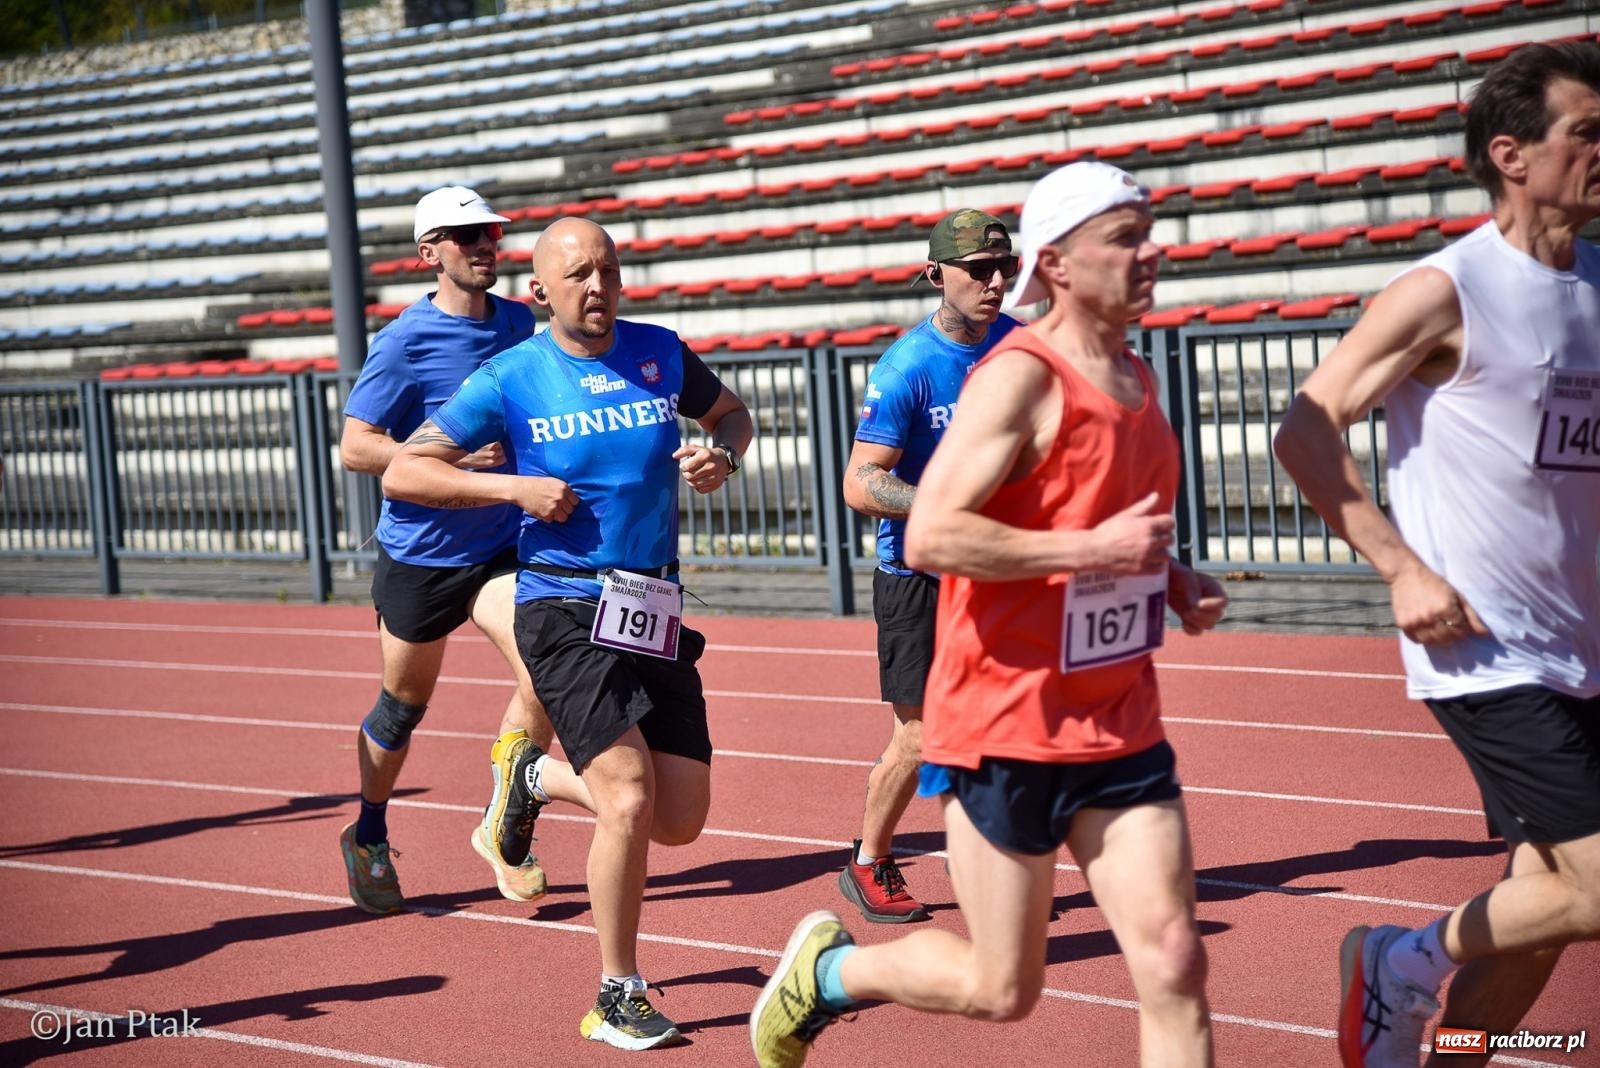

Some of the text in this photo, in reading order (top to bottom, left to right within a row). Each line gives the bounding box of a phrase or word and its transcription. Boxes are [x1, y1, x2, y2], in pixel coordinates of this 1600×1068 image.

[527, 393, 679, 444] RUNNERS
[629, 580, 645, 590] BIEG
[645, 583, 656, 593] BEZ
[618, 606, 658, 641] 191
[1085, 602, 1138, 649] 167
